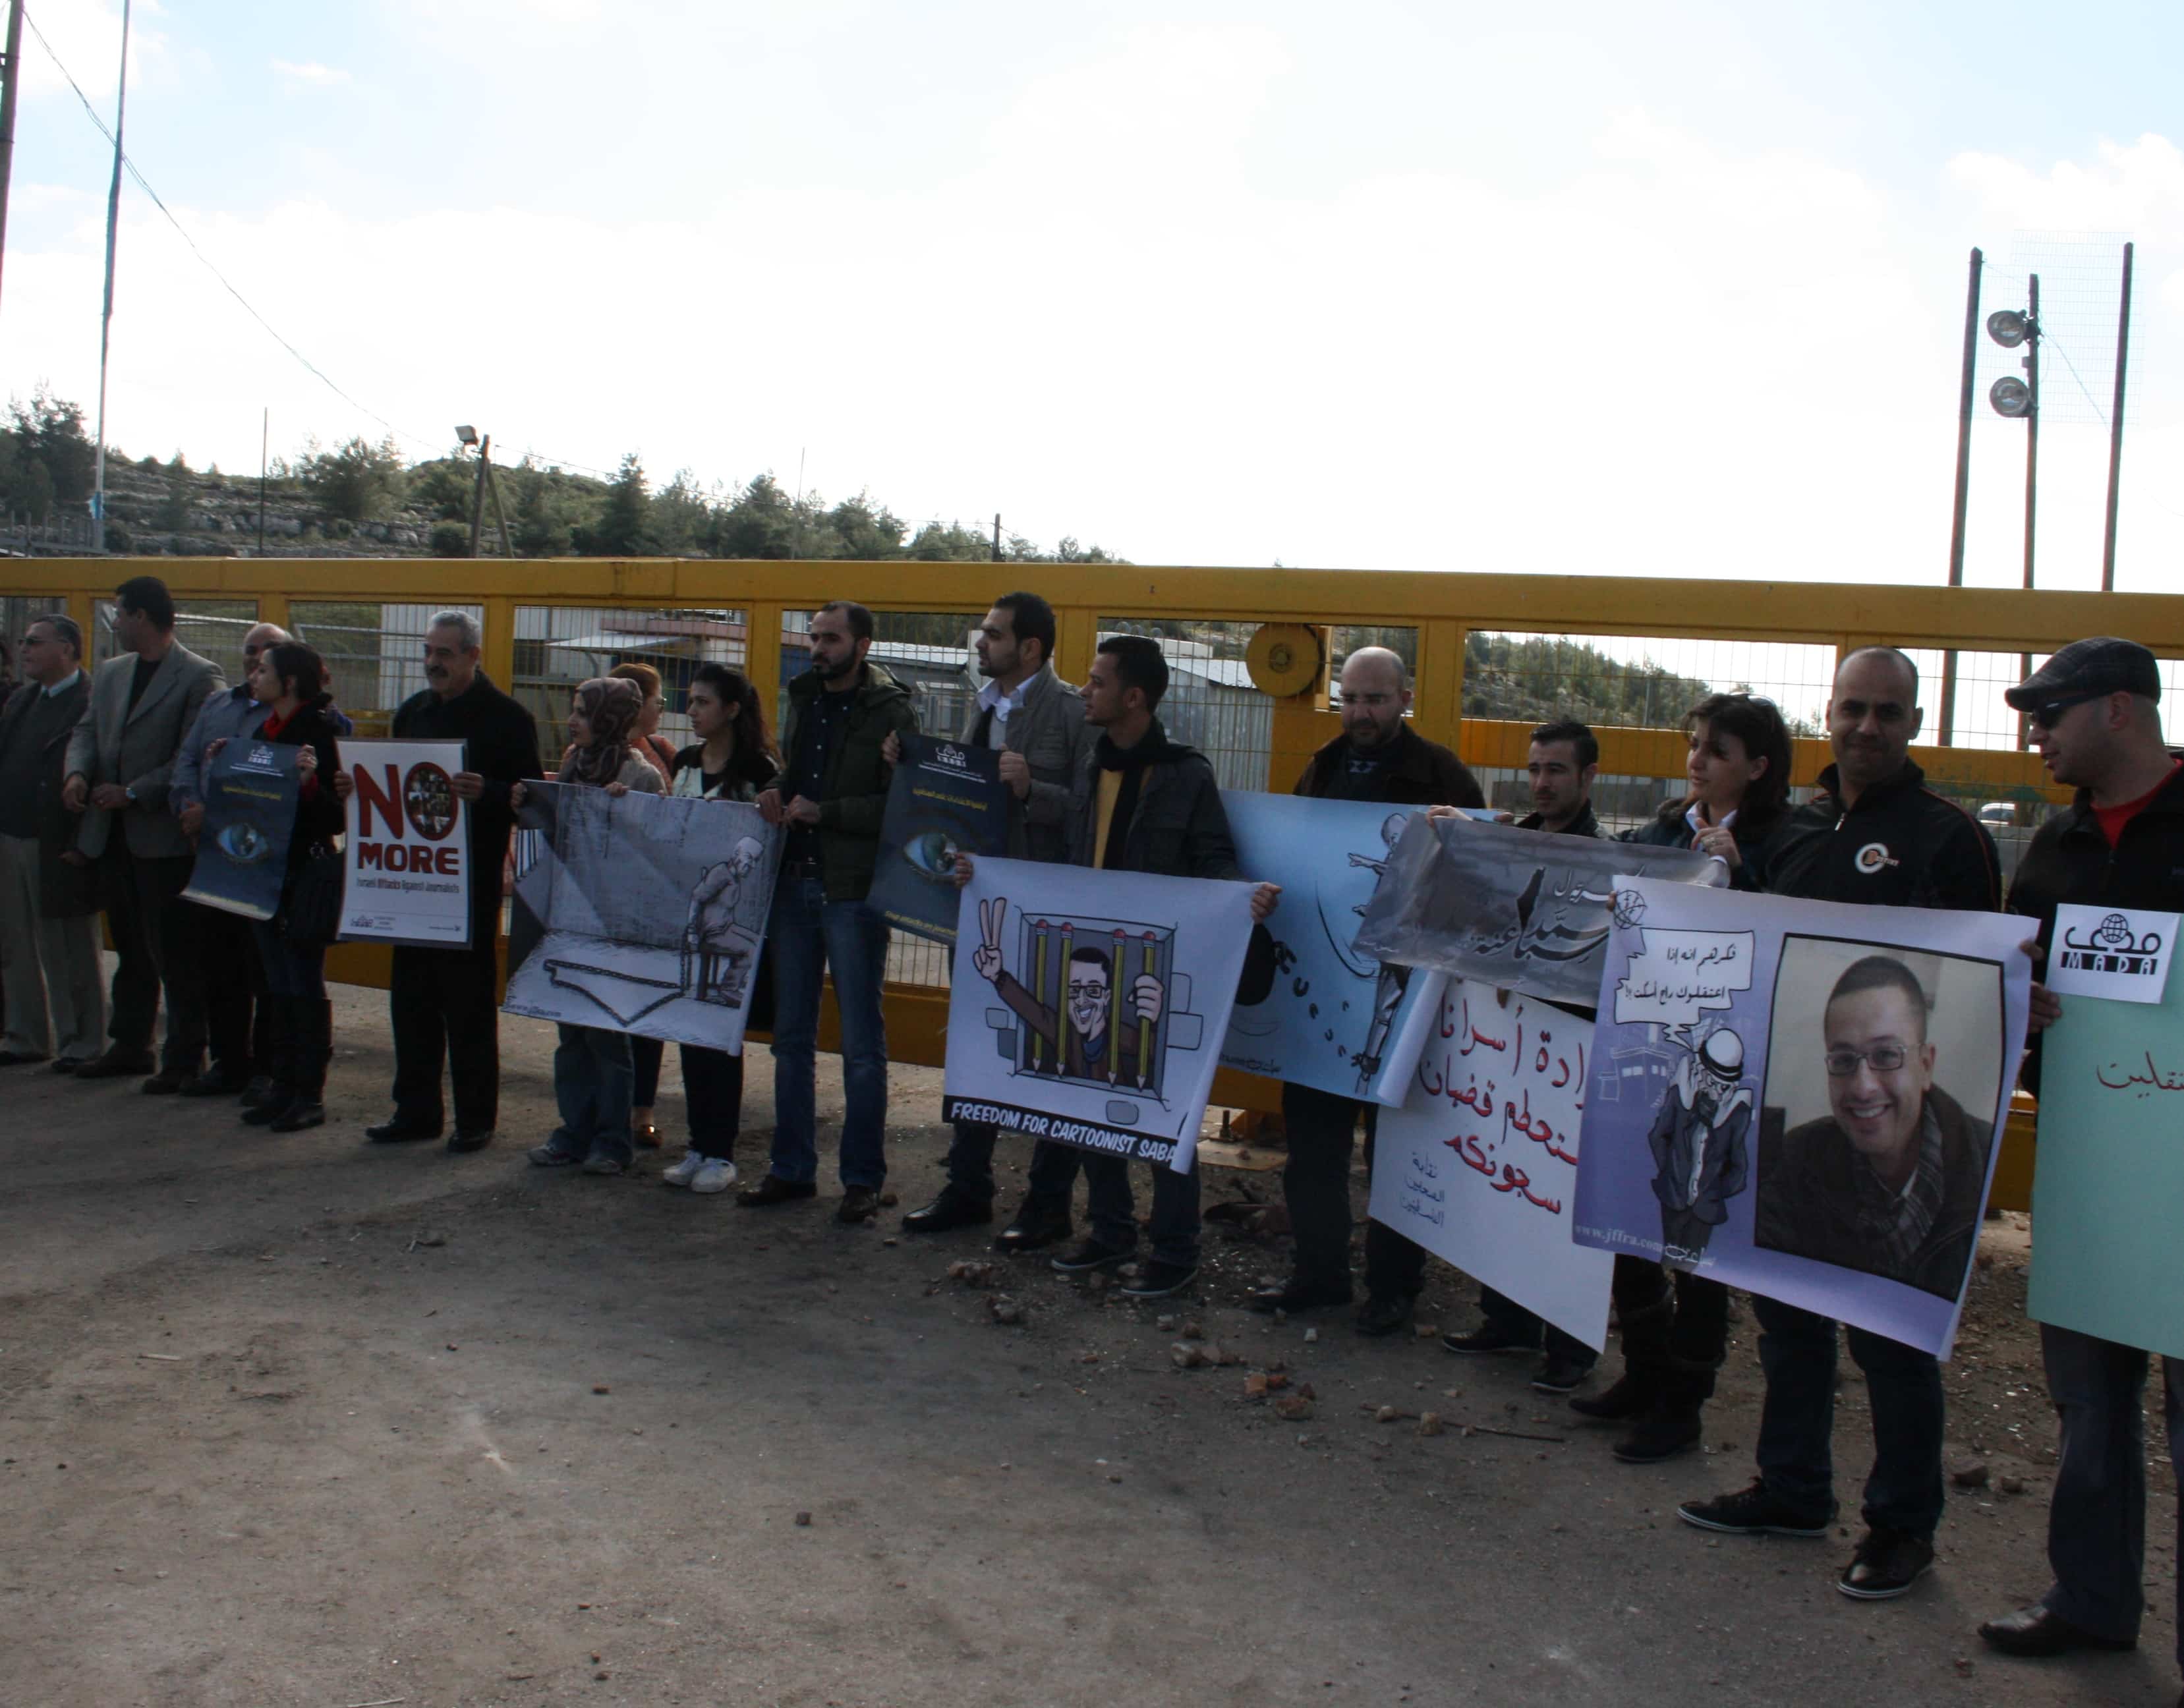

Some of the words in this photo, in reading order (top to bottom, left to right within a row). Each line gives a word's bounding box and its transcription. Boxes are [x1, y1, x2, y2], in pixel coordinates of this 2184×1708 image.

[353, 762, 459, 841] NO
[357, 842, 459, 876] MORE
[2063, 952, 2155, 975] MADA
[951, 1102, 1021, 1128] FREEDOM
[1021, 1114, 1049, 1136] FOR
[1050, 1120, 1137, 1154] CARTOONIST
